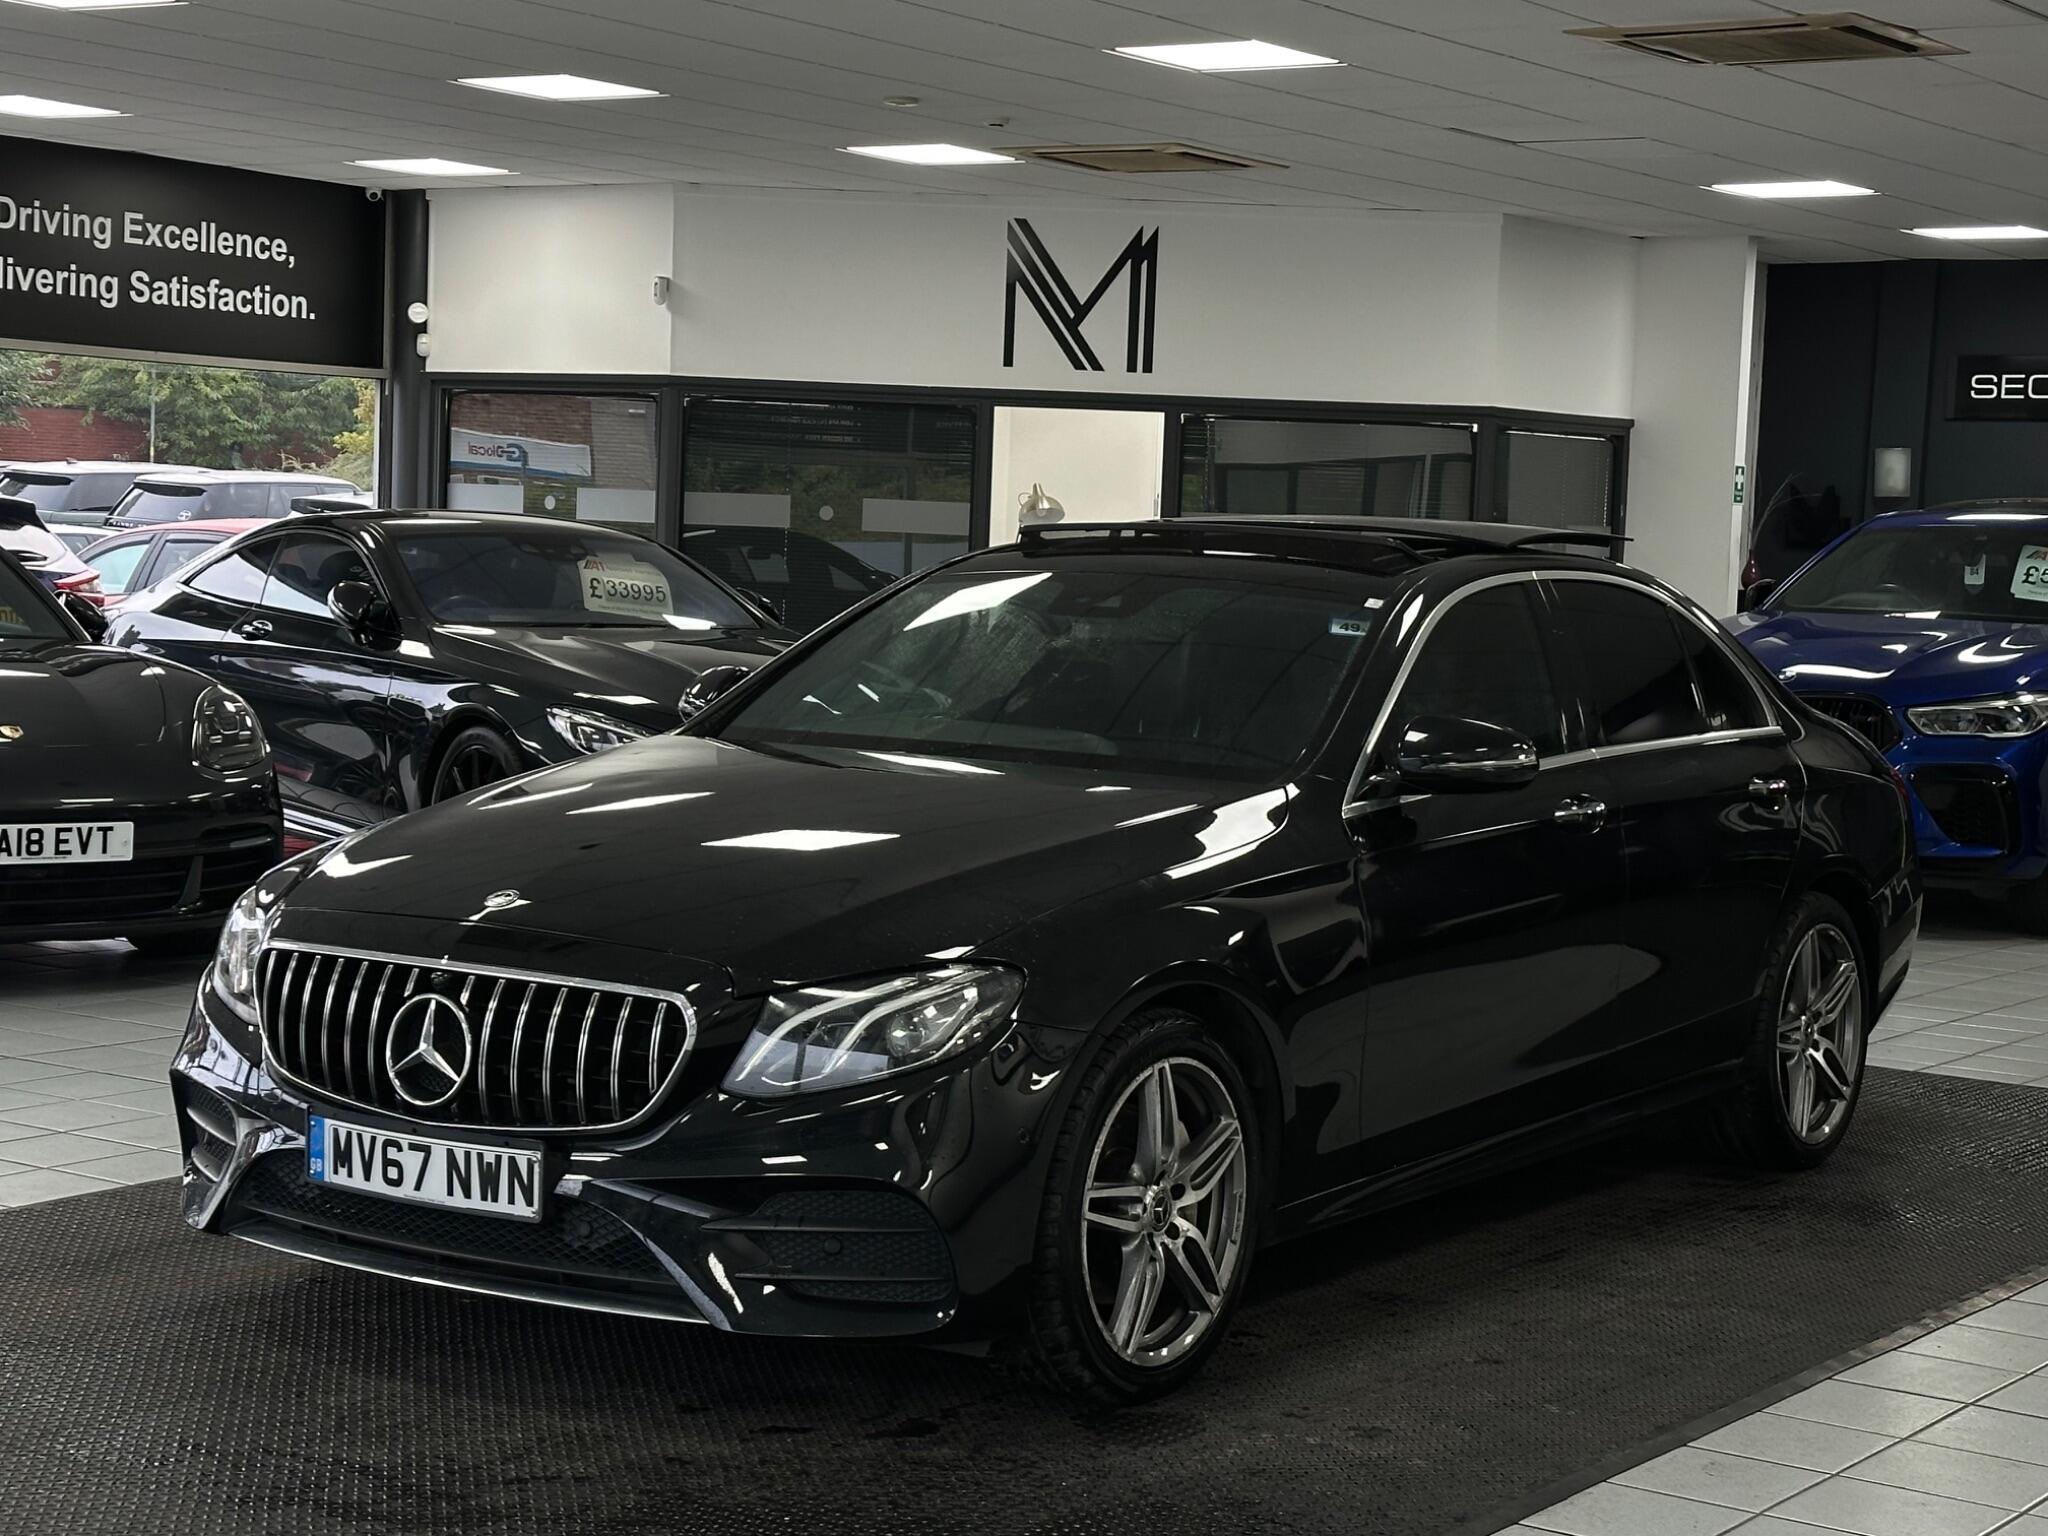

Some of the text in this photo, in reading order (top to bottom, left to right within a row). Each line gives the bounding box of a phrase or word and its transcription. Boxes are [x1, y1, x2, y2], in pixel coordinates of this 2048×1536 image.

[0, 196, 295, 268] Driving Excellence,
[129, 270, 316, 320] Satisfaction.
[589, 577, 667, 603] £33995
[54, 826, 114, 856] EVT
[332, 1127, 535, 1208] MV67 NWN
